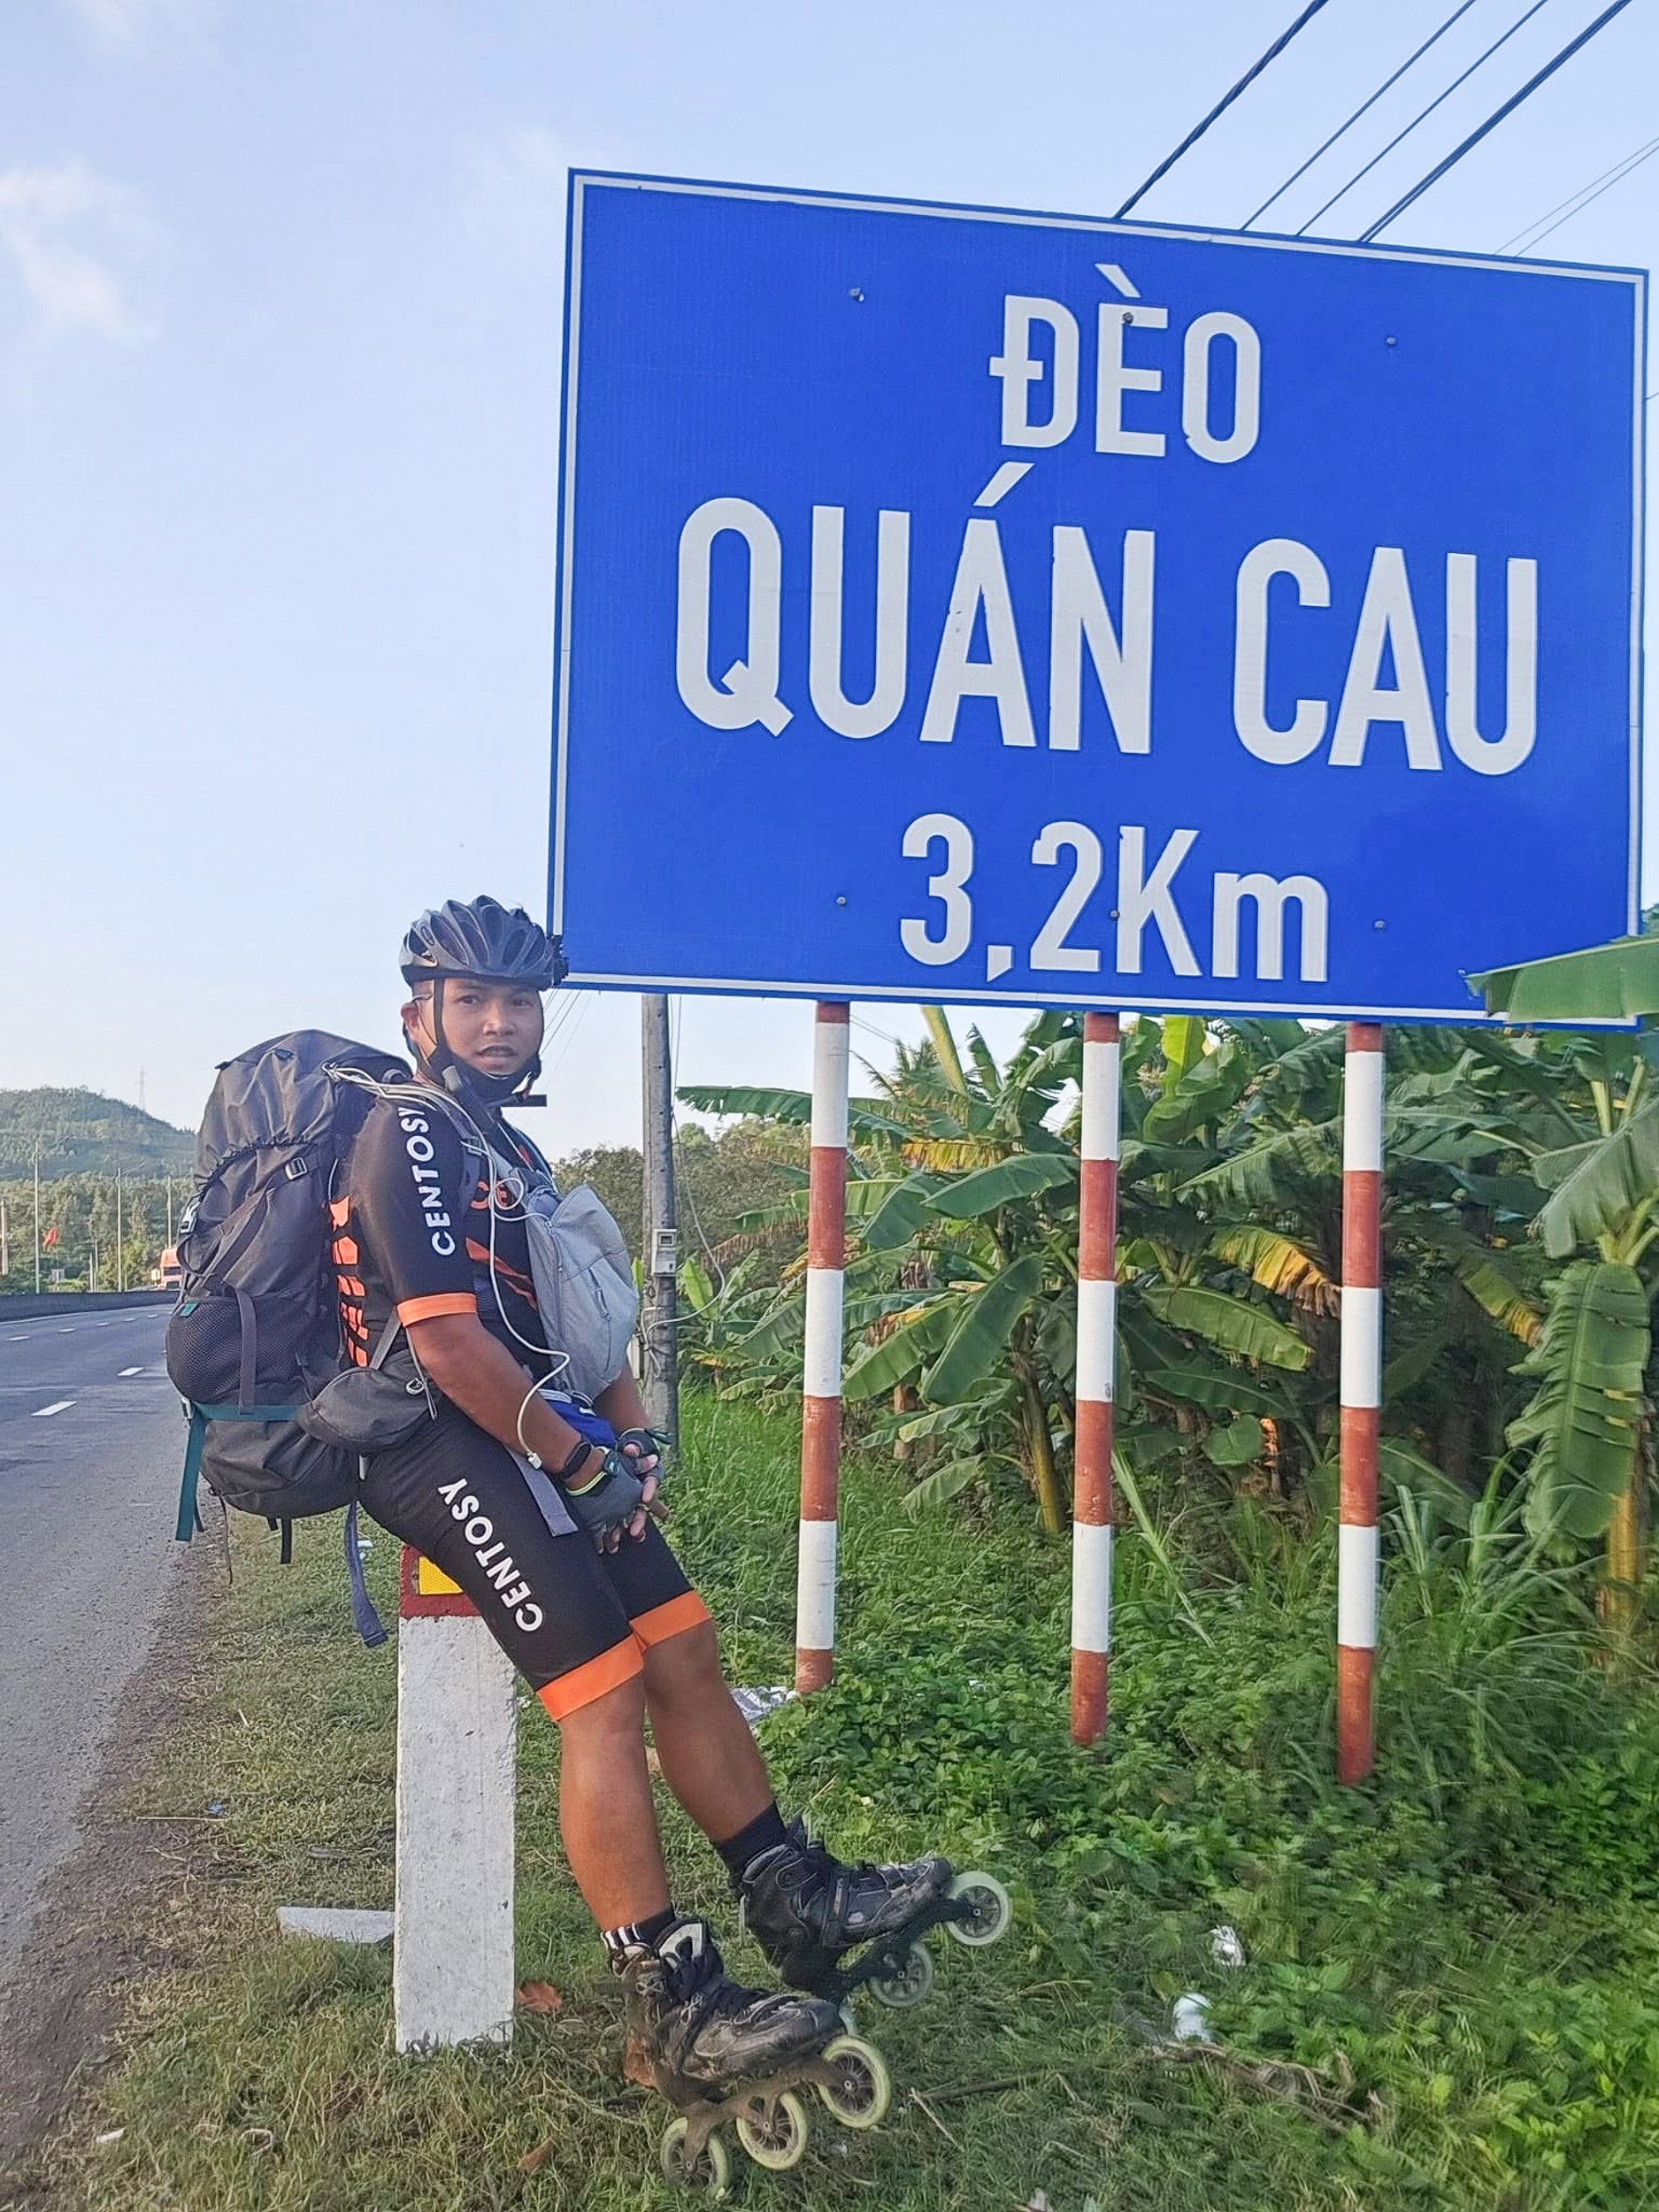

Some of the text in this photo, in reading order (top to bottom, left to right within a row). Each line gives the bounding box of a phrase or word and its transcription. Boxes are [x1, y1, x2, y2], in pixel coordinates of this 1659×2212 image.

[989, 264, 1260, 464] ĐÈO
[676, 461, 1537, 775] QUÁN CAU
[901, 813, 1330, 982] 3,2Km
[398, 1106, 457, 1256] CENTOSY
[437, 1478, 543, 1632] CENTOSY
